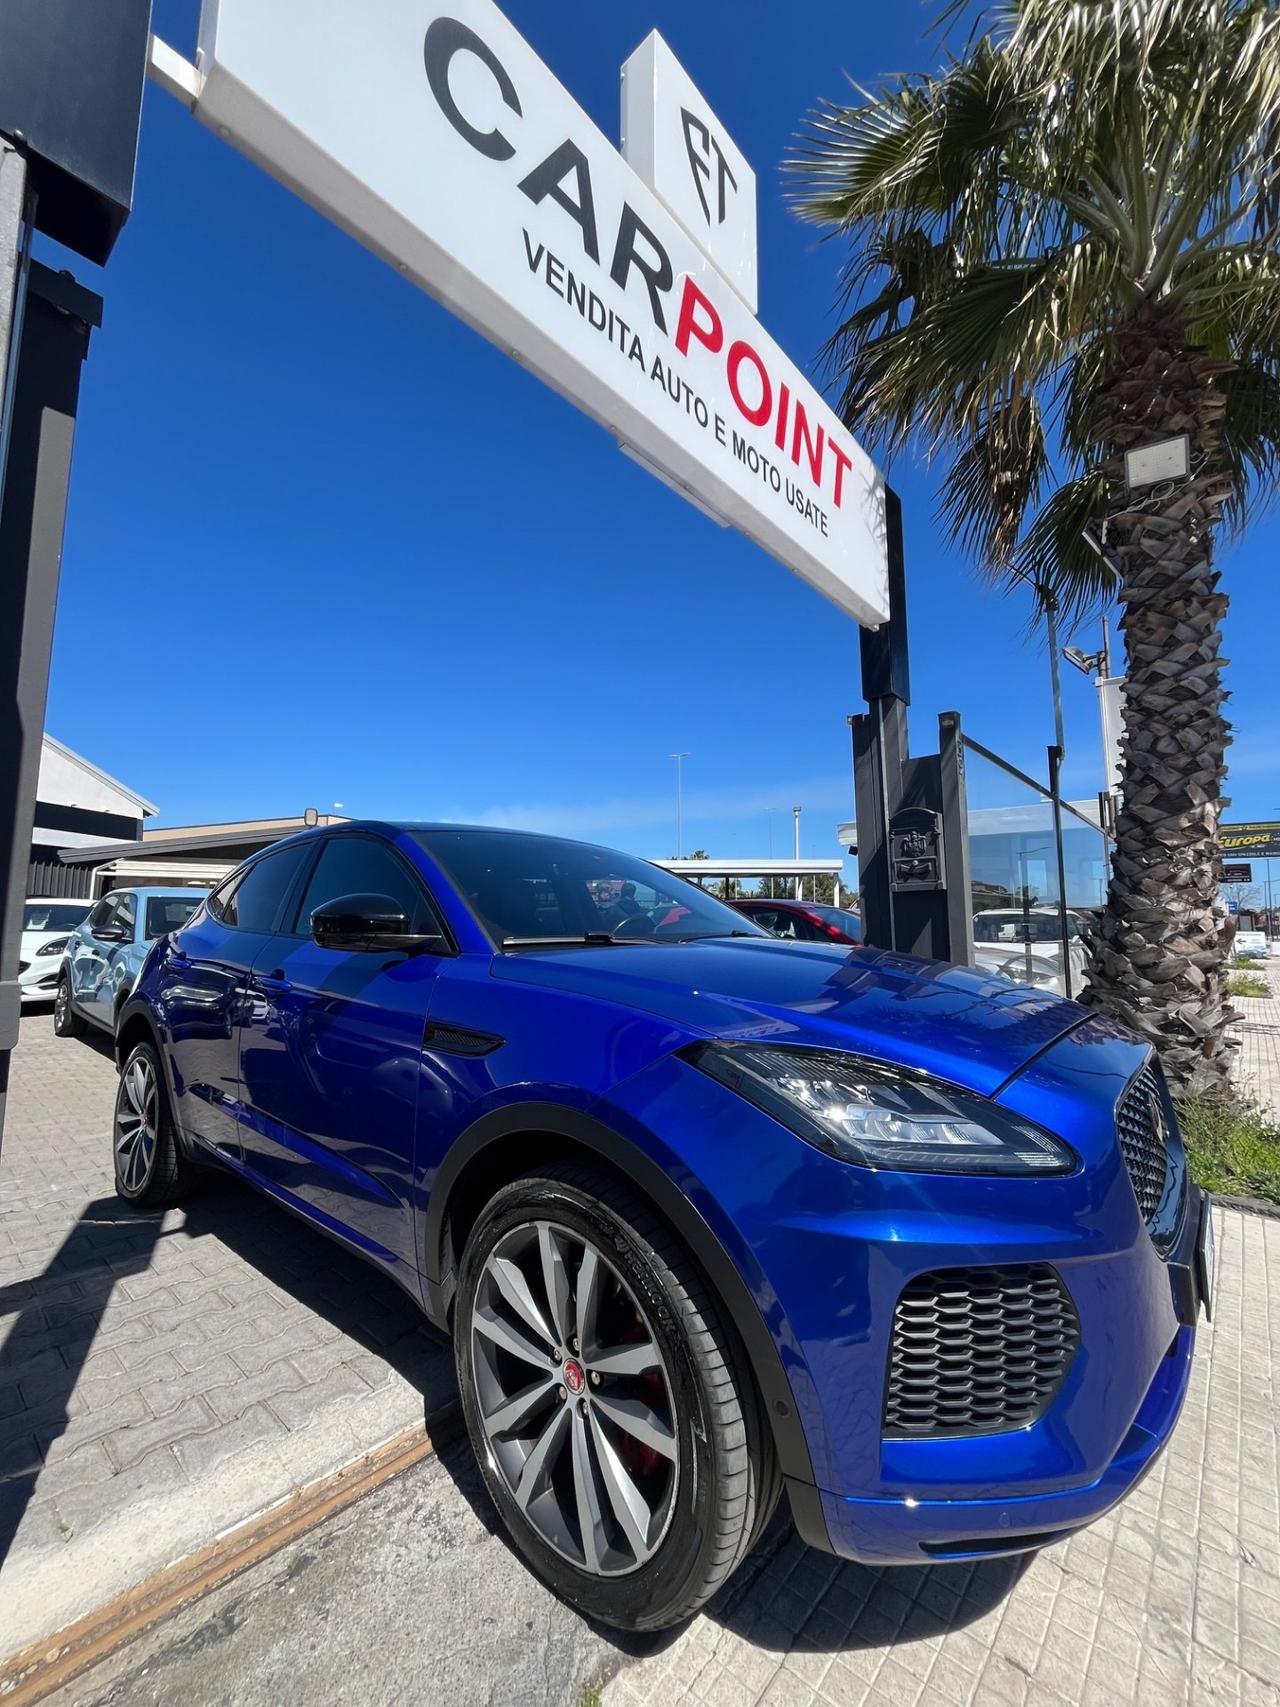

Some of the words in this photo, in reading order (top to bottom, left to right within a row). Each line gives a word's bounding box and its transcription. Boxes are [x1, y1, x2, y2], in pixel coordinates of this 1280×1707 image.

[423, 17, 853, 508] CARPOINT
[522, 228, 646, 373] VENDITA
[650, 356, 708, 428] AUTO
[714, 414, 726, 447] E
[732, 430, 781, 493] MOTO
[786, 477, 829, 538] USATE
